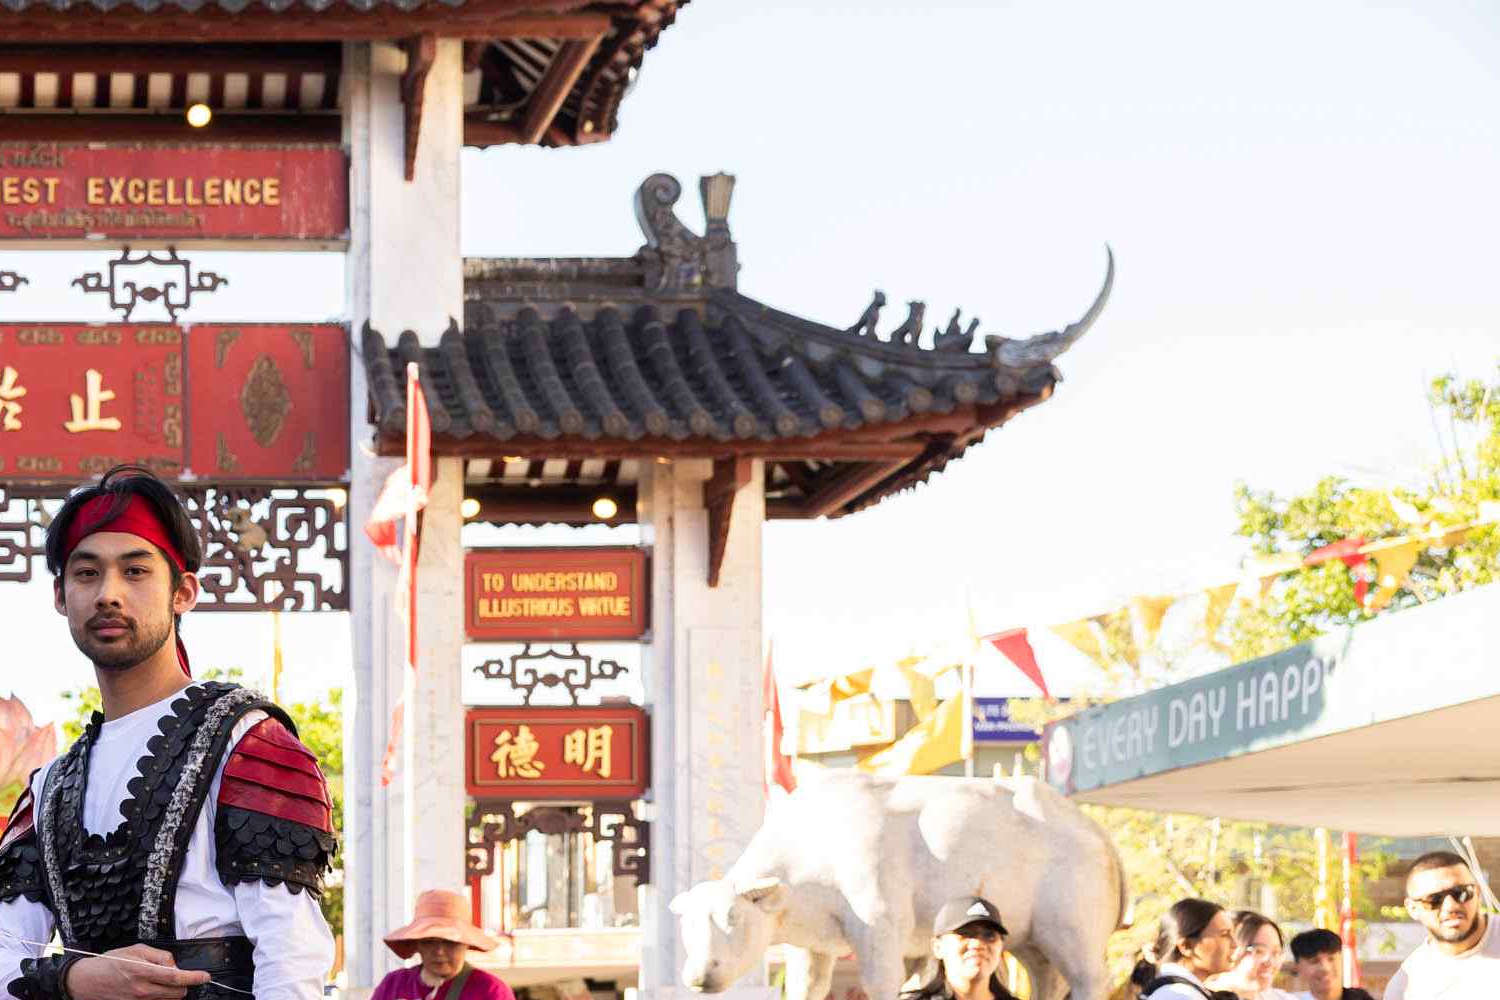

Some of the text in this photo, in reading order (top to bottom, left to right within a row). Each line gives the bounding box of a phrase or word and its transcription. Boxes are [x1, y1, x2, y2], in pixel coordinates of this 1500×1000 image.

[86, 176, 281, 206] EXCELLENCE
[482, 571, 618, 593] TO UNDERSTAND
[479, 596, 631, 617] ILLUSTRIOUS VIRTUE
[1082, 704, 1159, 769] EVERY
[1168, 686, 1227, 749] DAY
